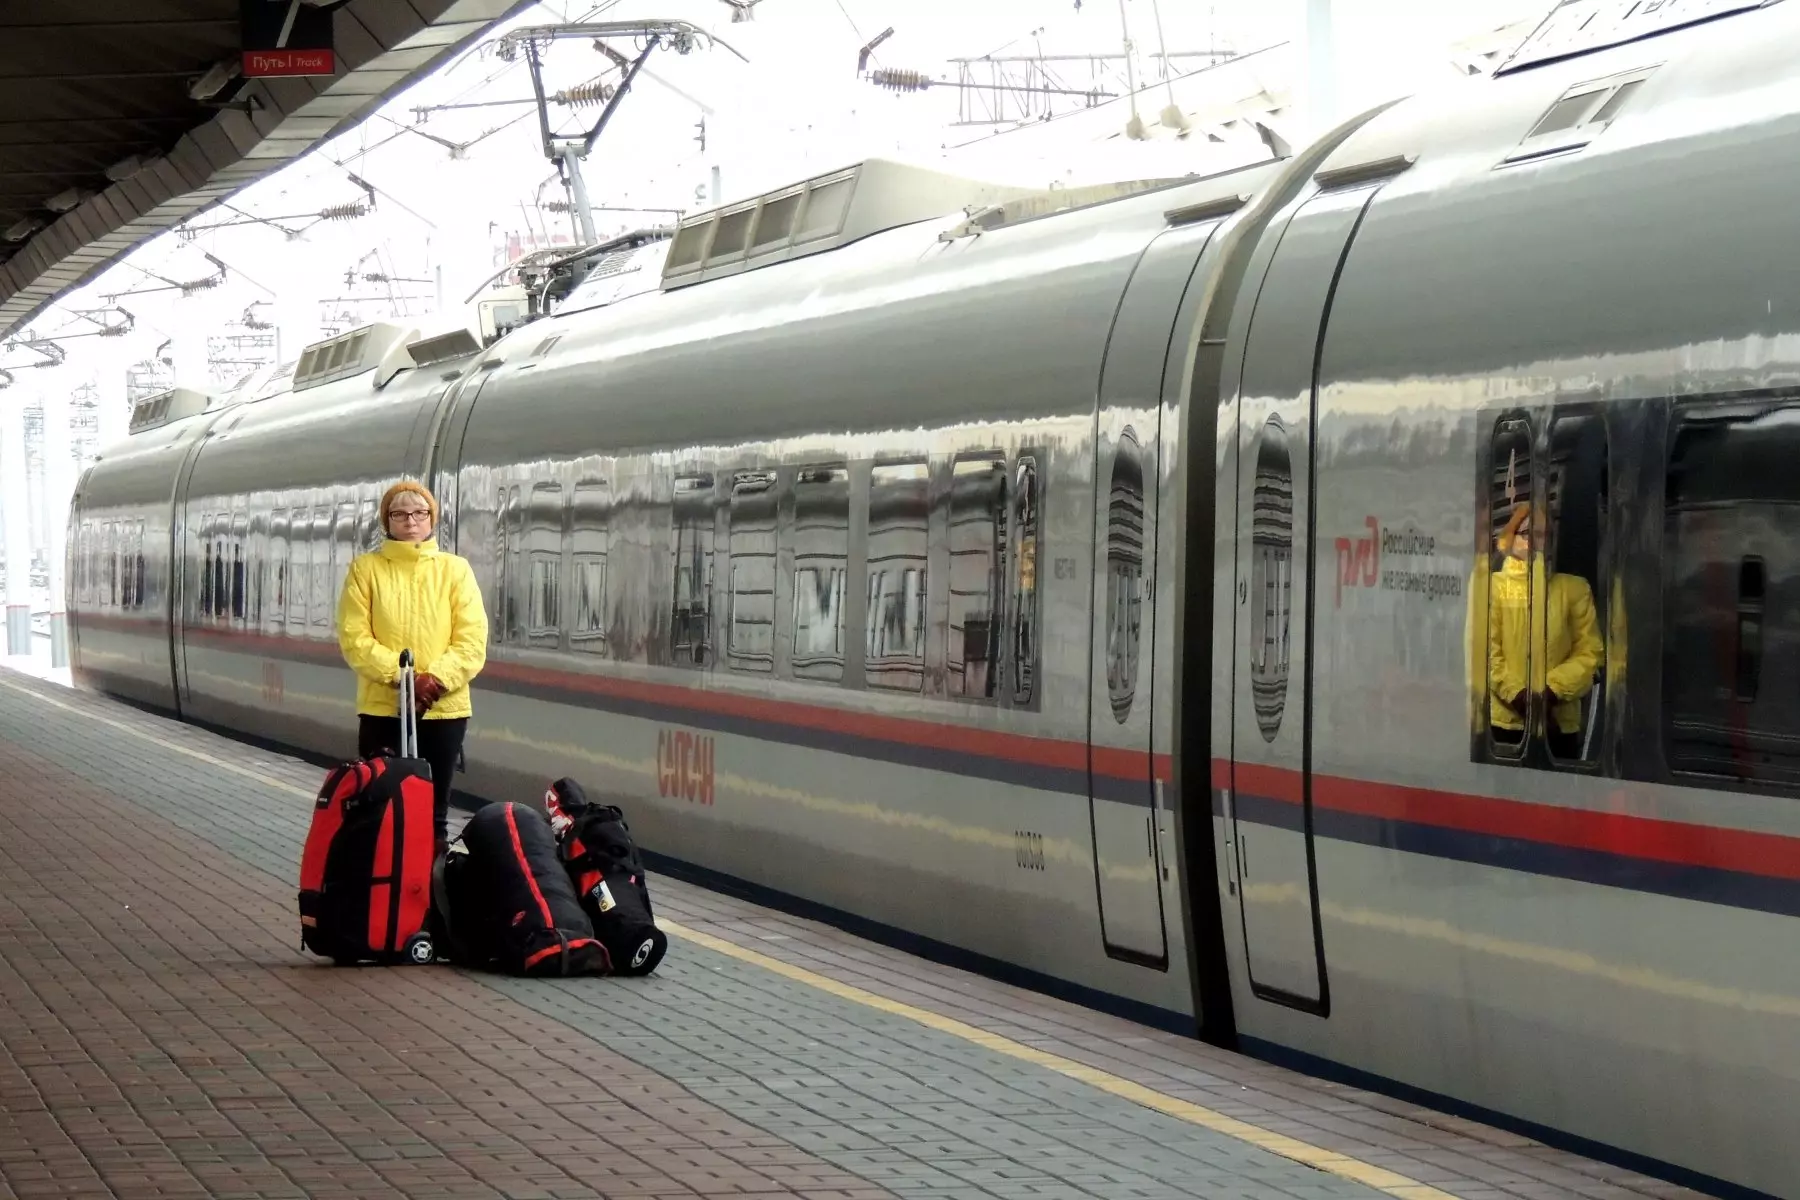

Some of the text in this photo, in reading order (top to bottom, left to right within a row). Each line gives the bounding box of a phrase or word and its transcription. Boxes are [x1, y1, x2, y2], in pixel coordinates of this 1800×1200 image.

[253, 56, 285, 71] Путь
[297, 57, 323, 67] Track
[1382, 527, 1435, 556] Российские
[657, 728, 715, 807] САПСАН
